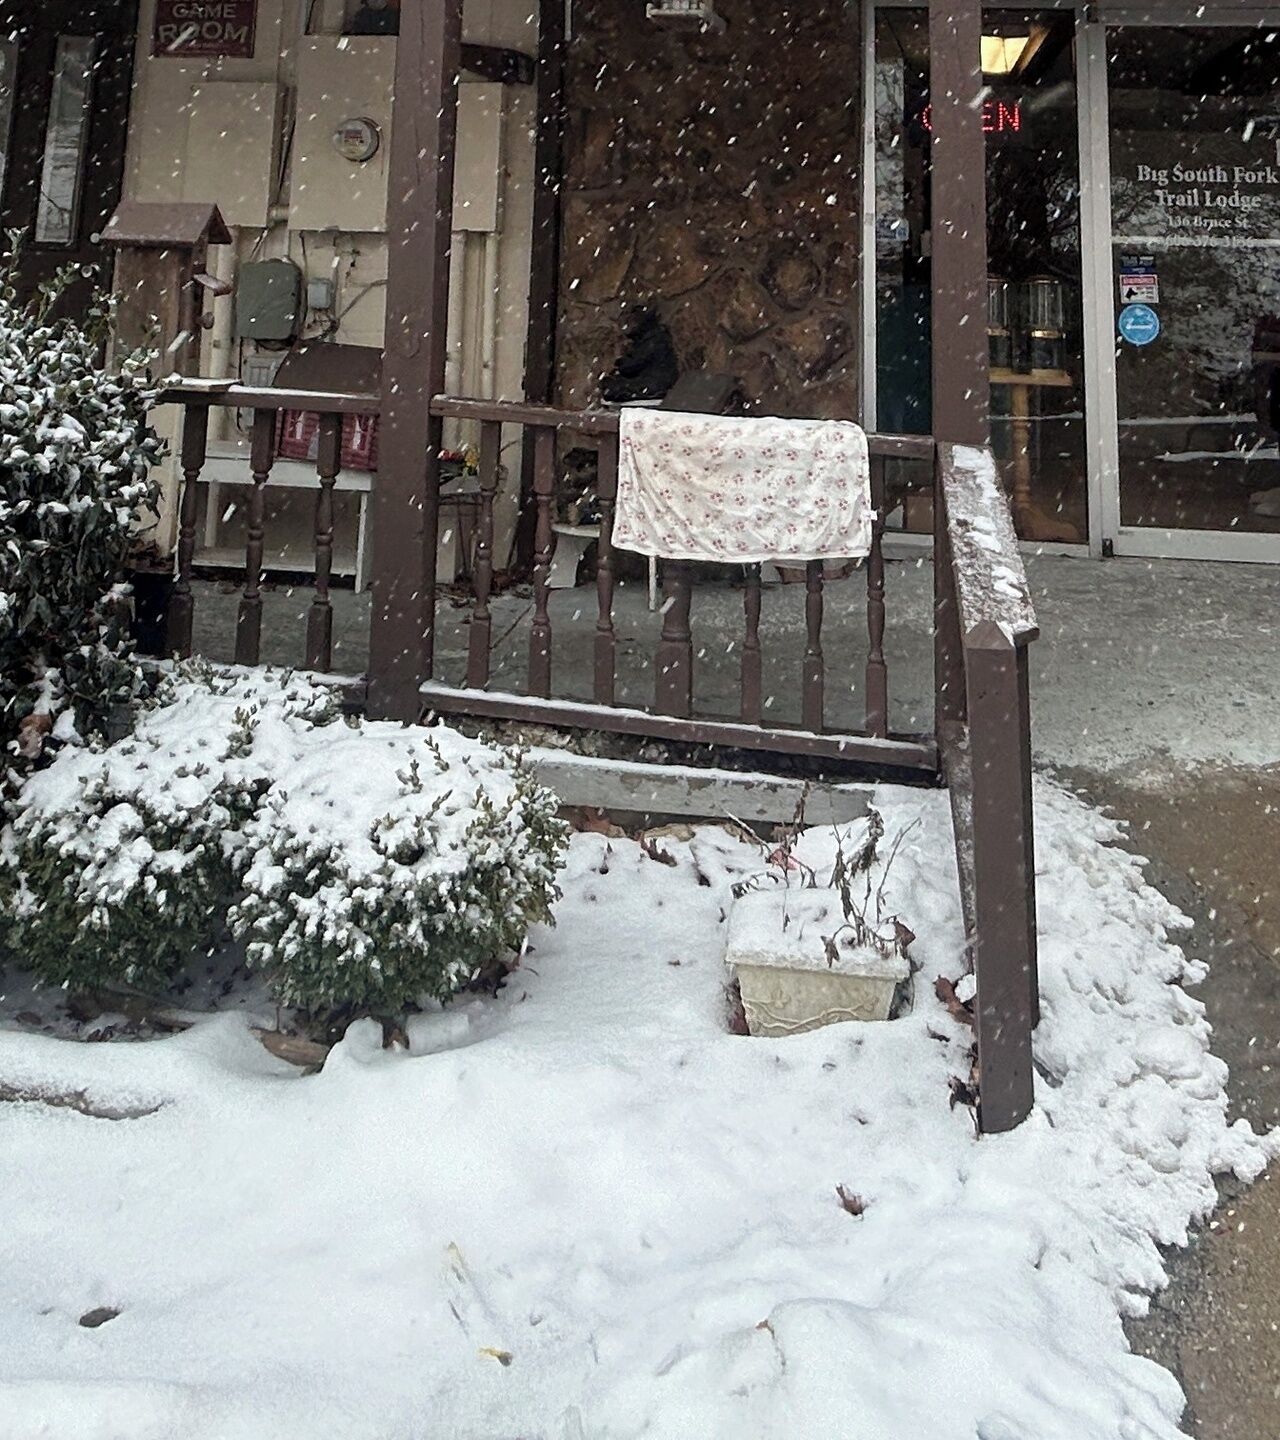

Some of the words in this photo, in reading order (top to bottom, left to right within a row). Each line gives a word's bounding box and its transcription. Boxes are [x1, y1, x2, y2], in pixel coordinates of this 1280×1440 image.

[172, 3, 237, 19] GAME
[158, 21, 249, 44] ROOM
[1137, 164, 1169, 187] Big
[1172, 163, 1229, 183] South
[1234, 165, 1280, 185] Fork
[1154, 188, 1200, 208] Trail
[1204, 190, 1262, 214] Lodge
[1169, 215, 1190, 227] 136
